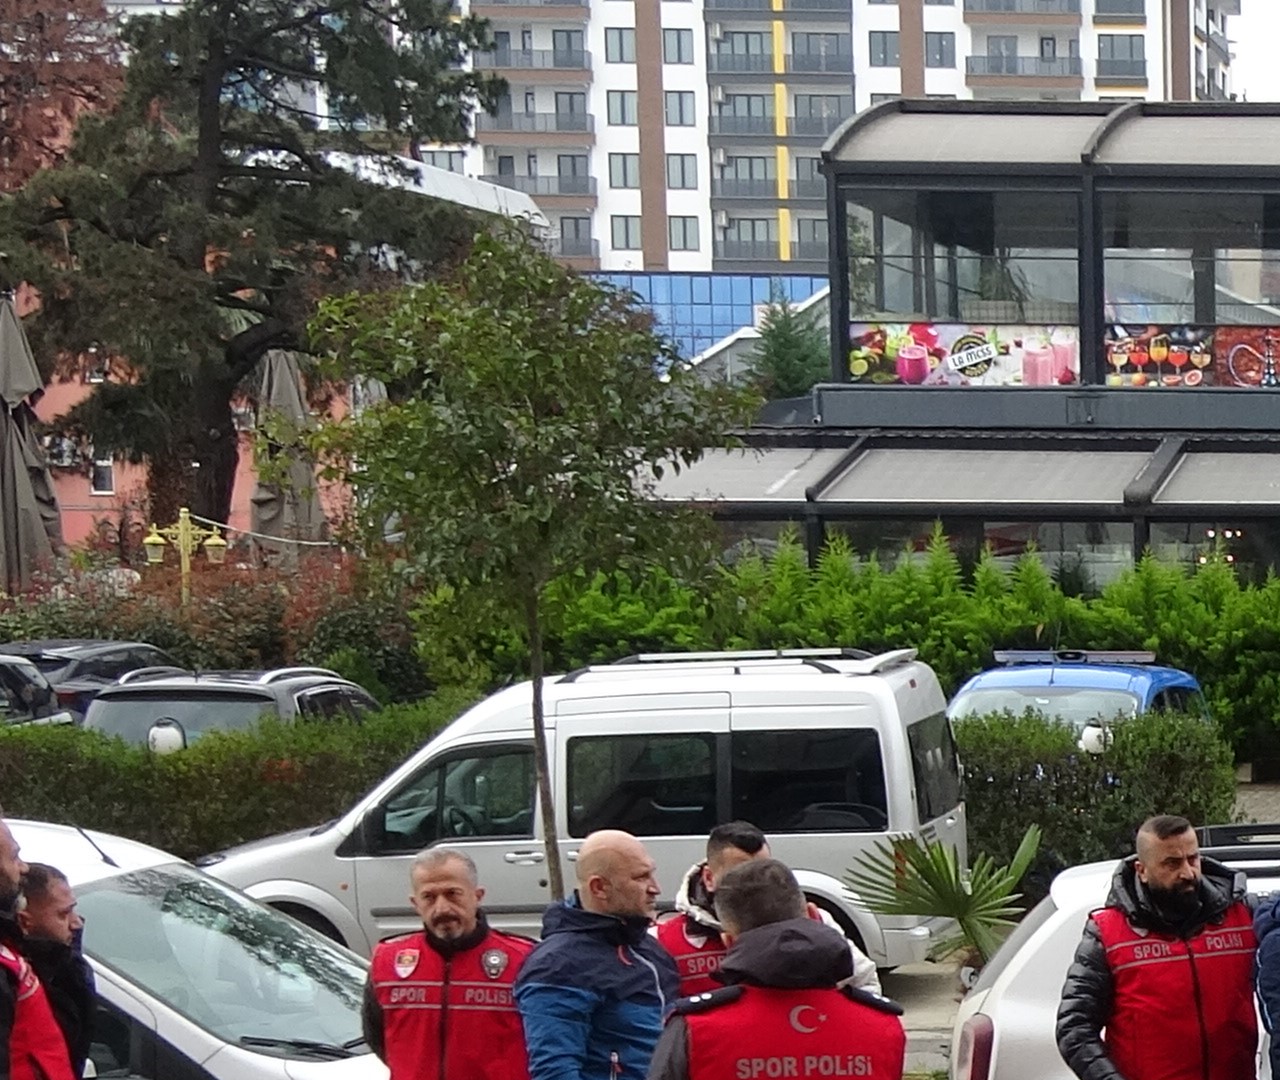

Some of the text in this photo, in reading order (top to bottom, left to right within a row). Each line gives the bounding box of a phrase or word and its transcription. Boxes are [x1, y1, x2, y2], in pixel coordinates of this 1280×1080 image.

[952, 356, 965, 367] LA
[1133, 942, 1172, 959] SPOR
[390, 987, 426, 1003] SPOR
[736, 1056, 798, 1080] SPOR
